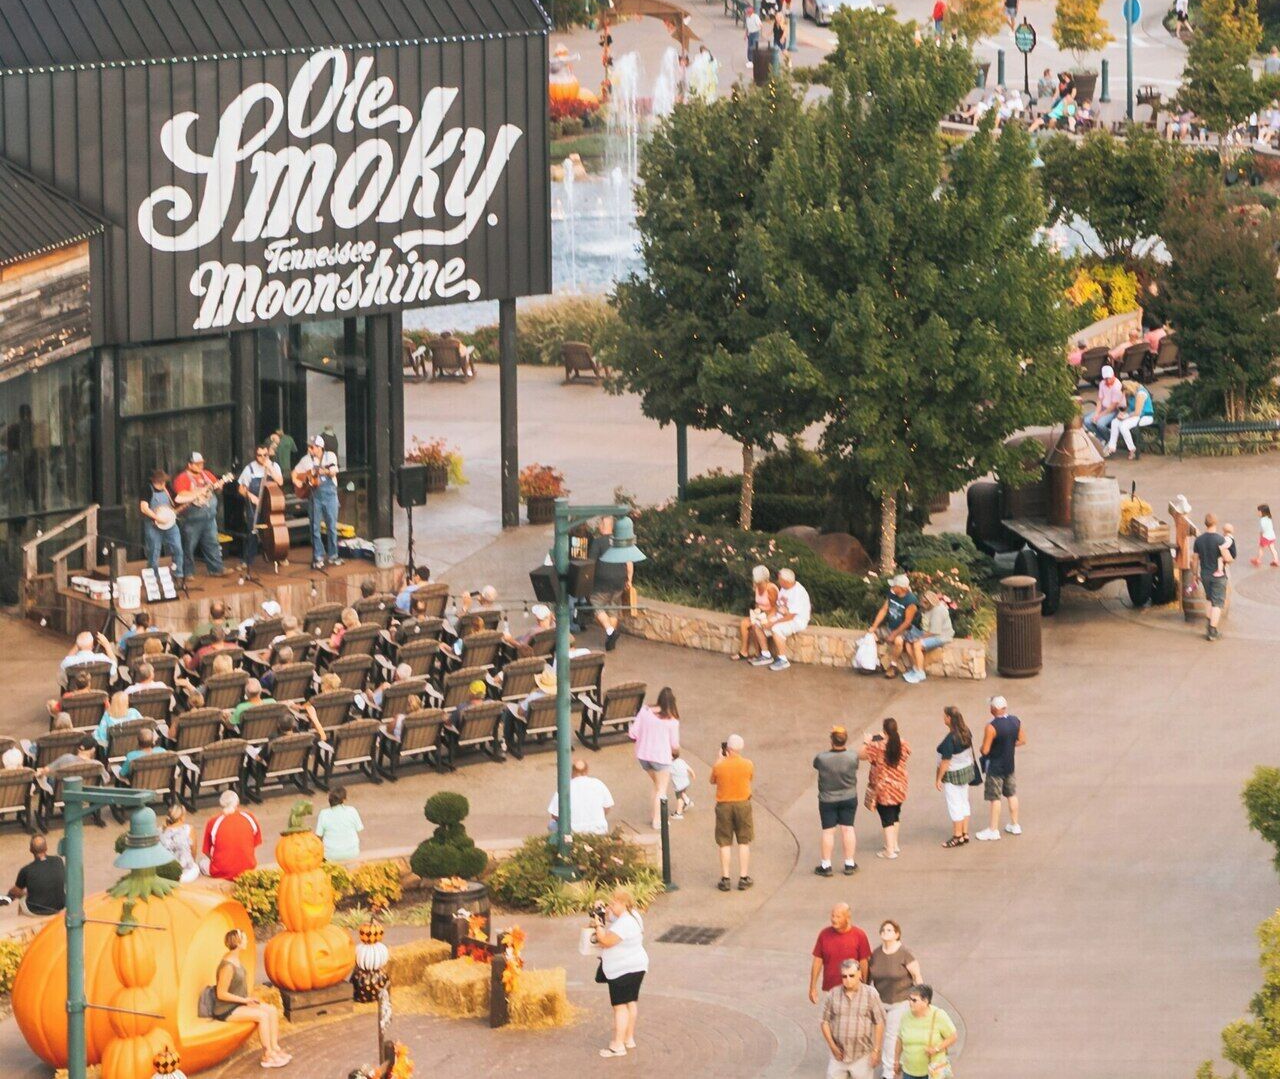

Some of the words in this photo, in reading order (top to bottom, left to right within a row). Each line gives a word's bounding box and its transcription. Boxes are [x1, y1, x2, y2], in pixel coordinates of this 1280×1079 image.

[288, 48, 413, 139] Ole
[189, 248, 481, 329] Moonshine
[265, 237, 376, 273] Tennessee
